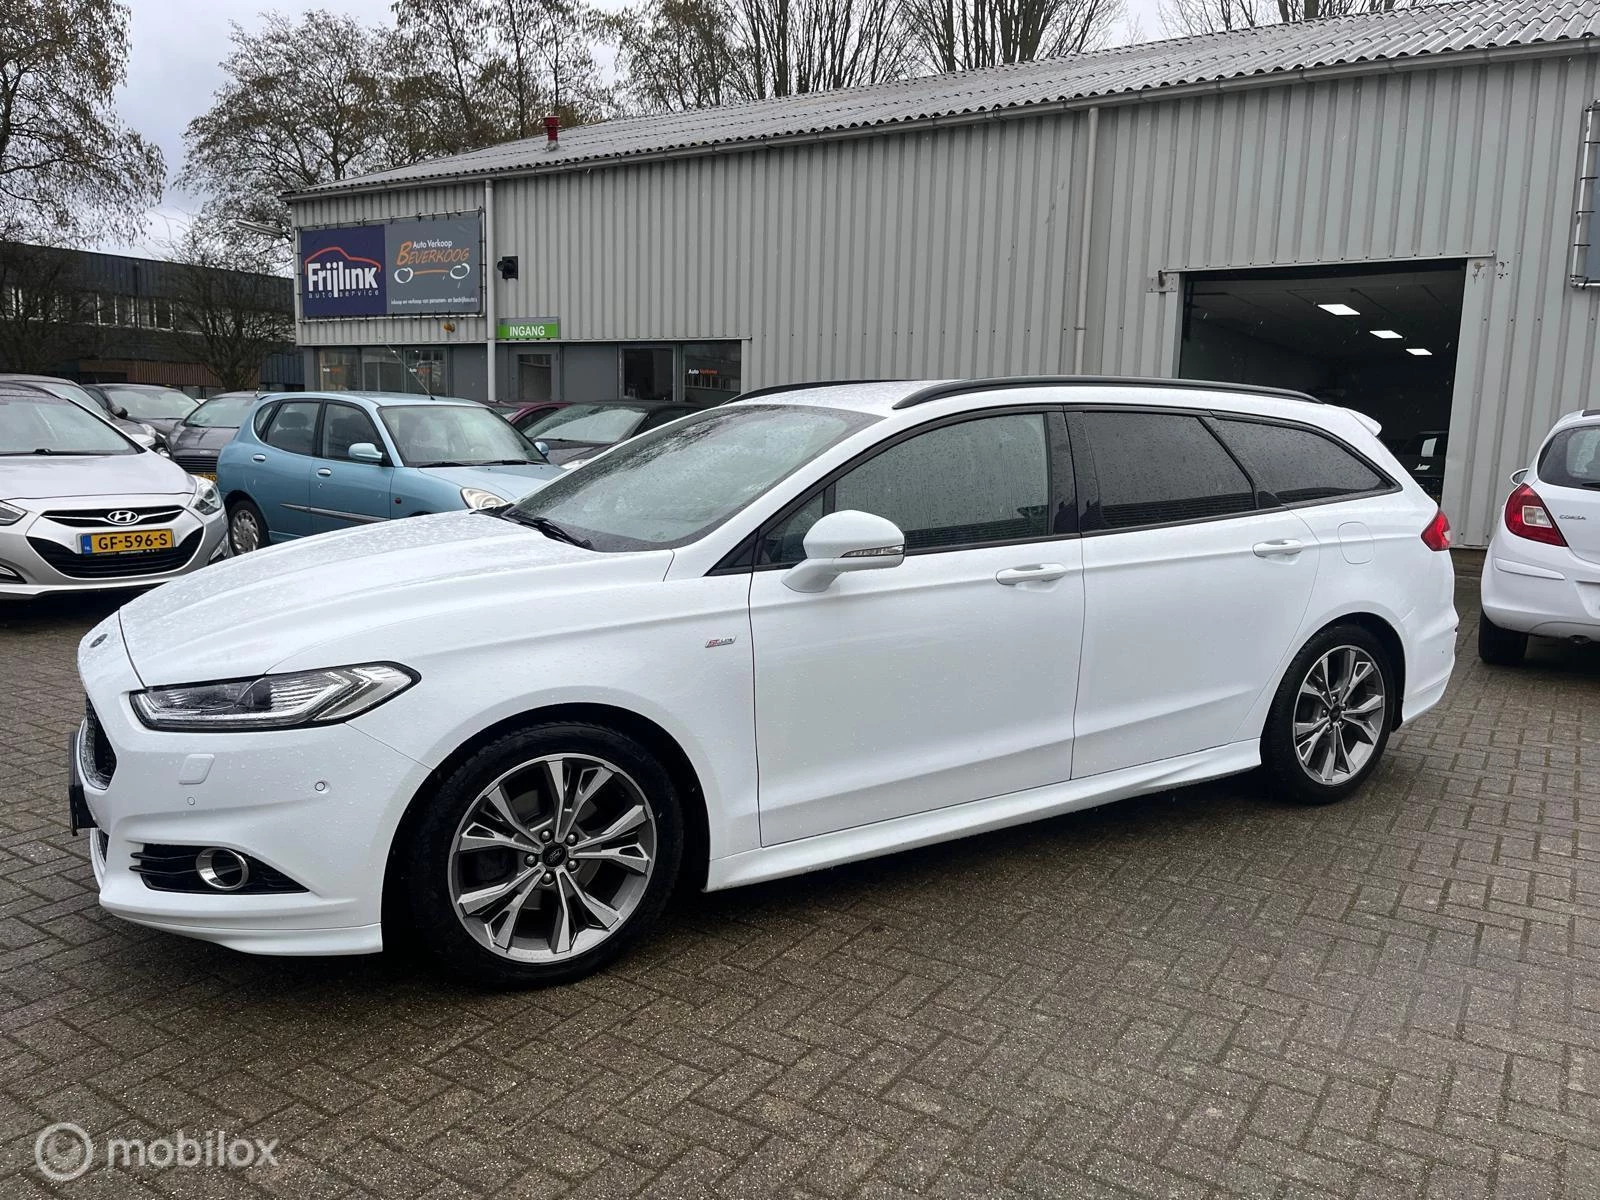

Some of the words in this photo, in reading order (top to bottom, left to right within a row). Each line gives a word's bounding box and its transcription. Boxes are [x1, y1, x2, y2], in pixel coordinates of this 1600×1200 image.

[413, 241, 426, 249] Auto
[427, 239, 453, 249] Verkoop
[396, 241, 470, 266] BEVERKOOG
[509, 326, 545, 336] INGANG
[98, 533, 168, 550] GF-596-S
